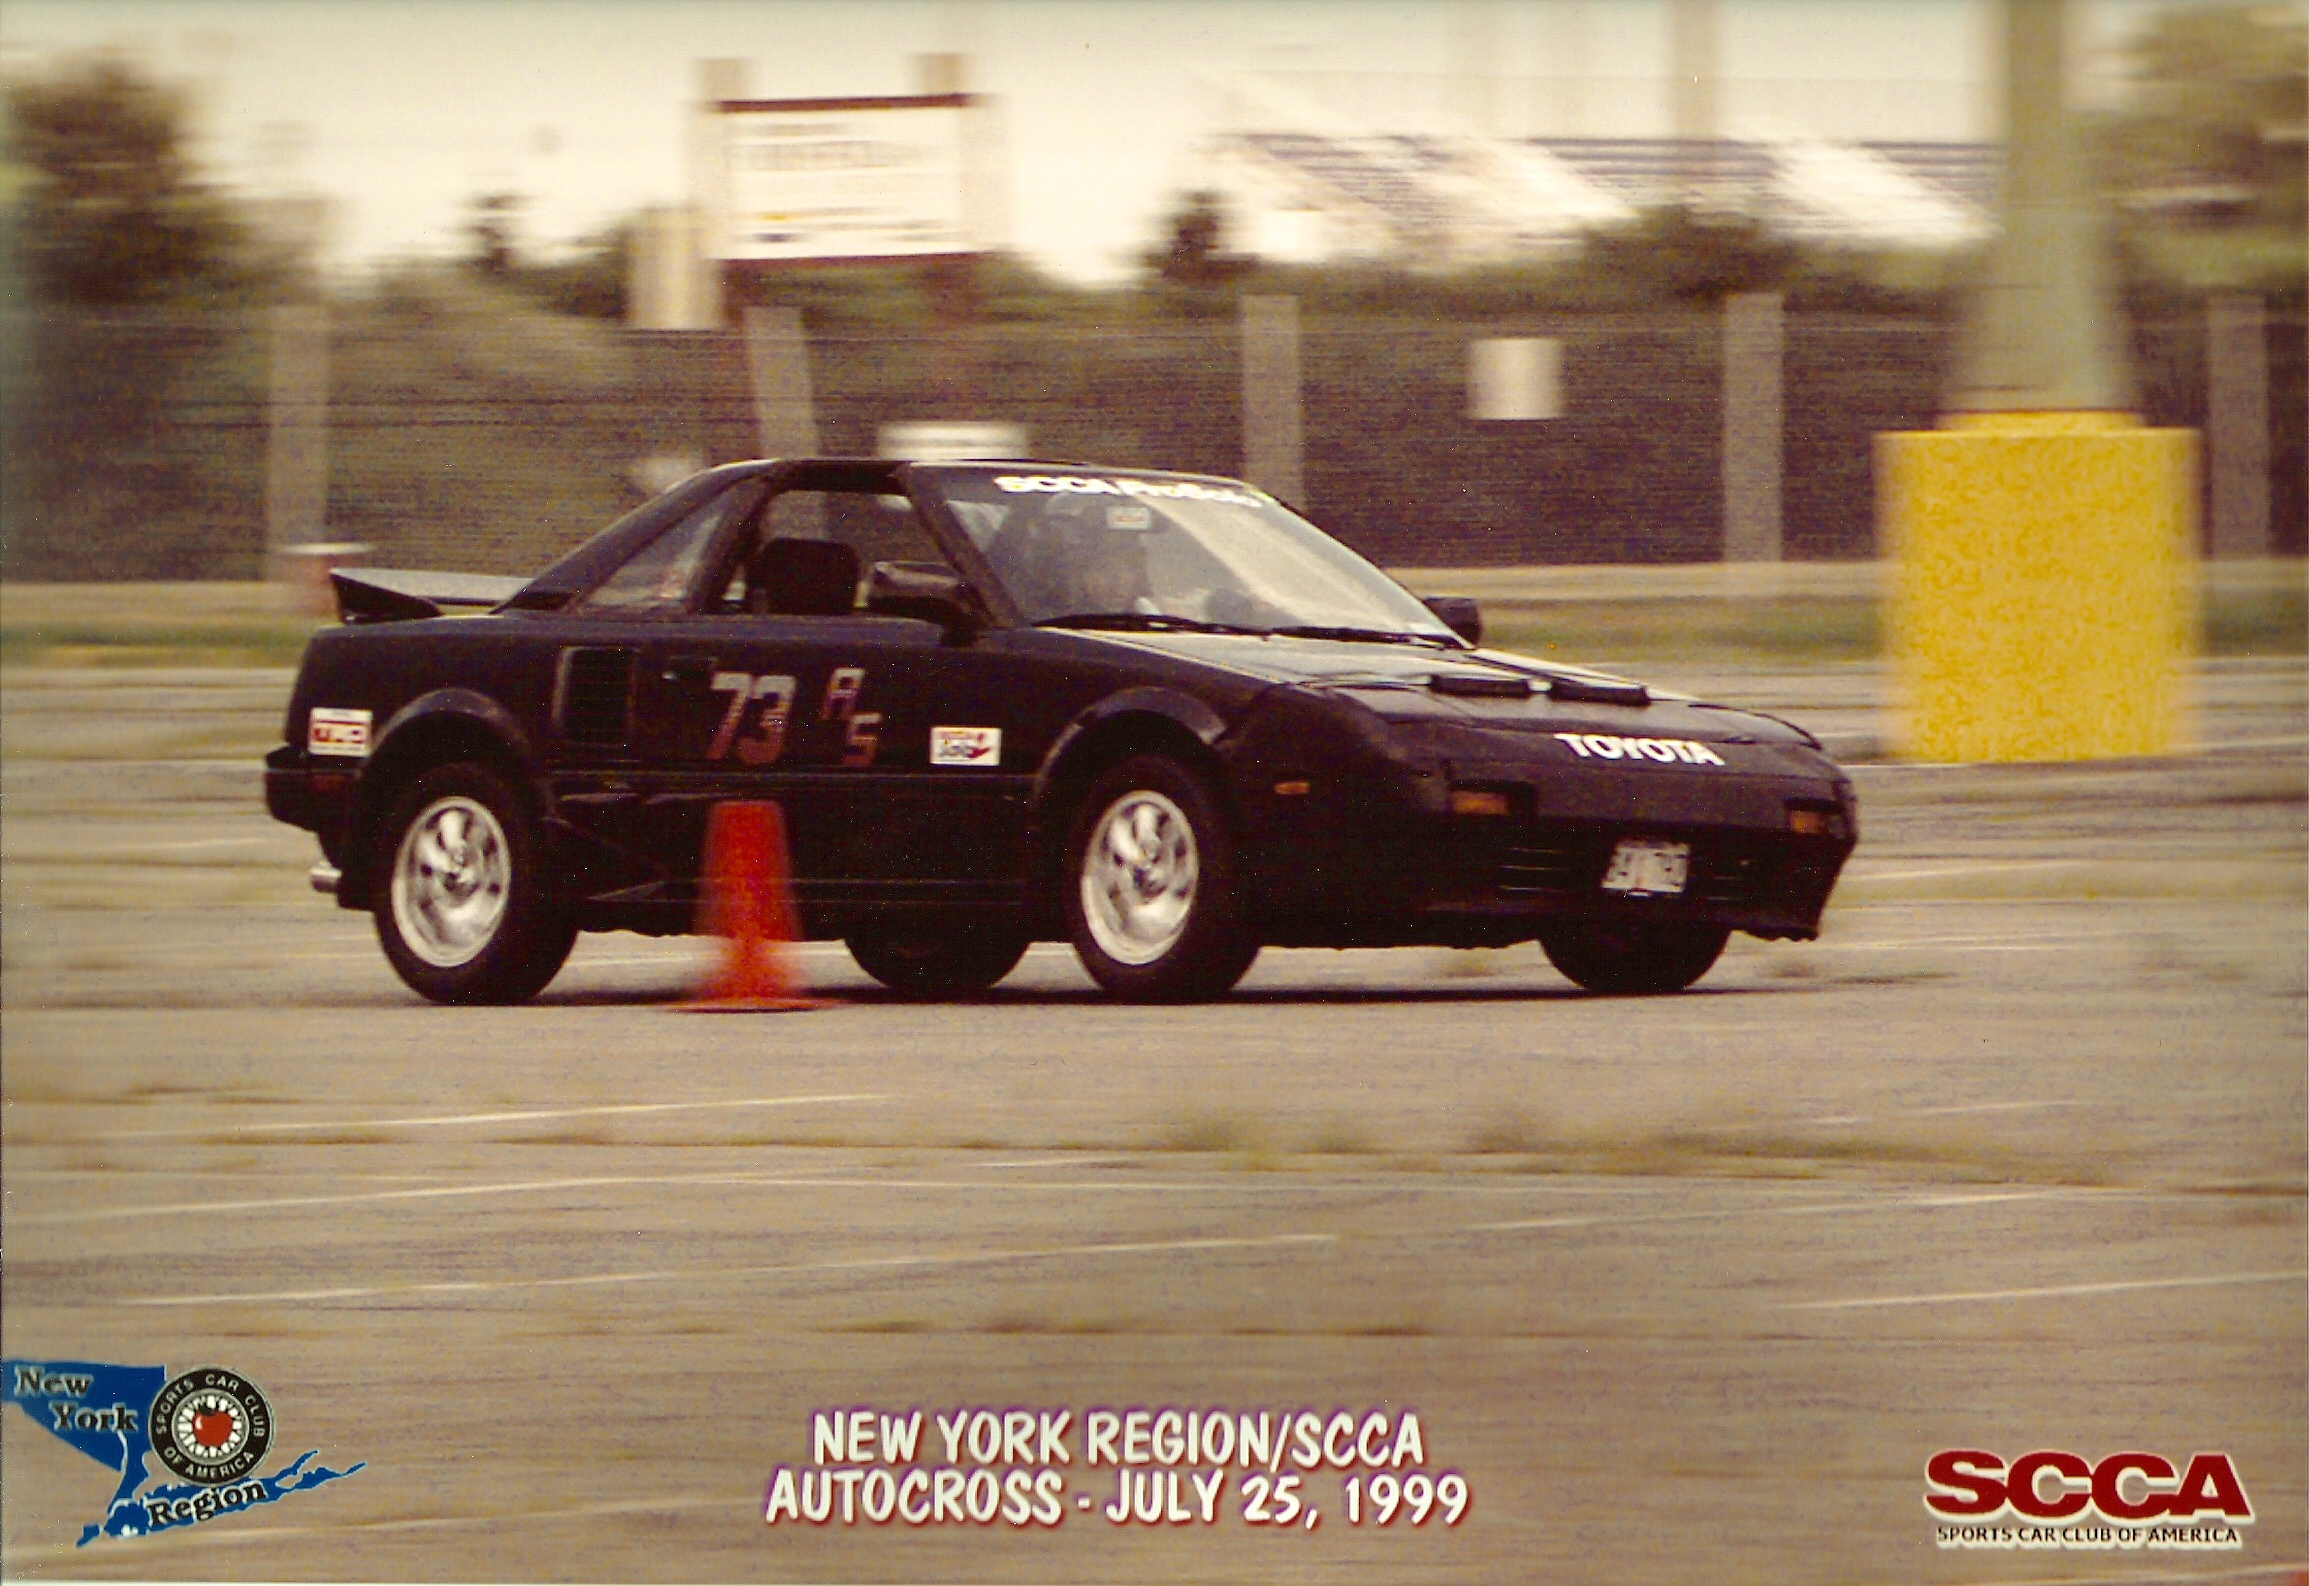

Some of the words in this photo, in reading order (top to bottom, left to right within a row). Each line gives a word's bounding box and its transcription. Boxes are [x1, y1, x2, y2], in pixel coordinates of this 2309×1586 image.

[993, 476, 1122, 495] SCCA
[704, 671, 796, 767] 73
[1553, 733, 1726, 766] TOYOTA
